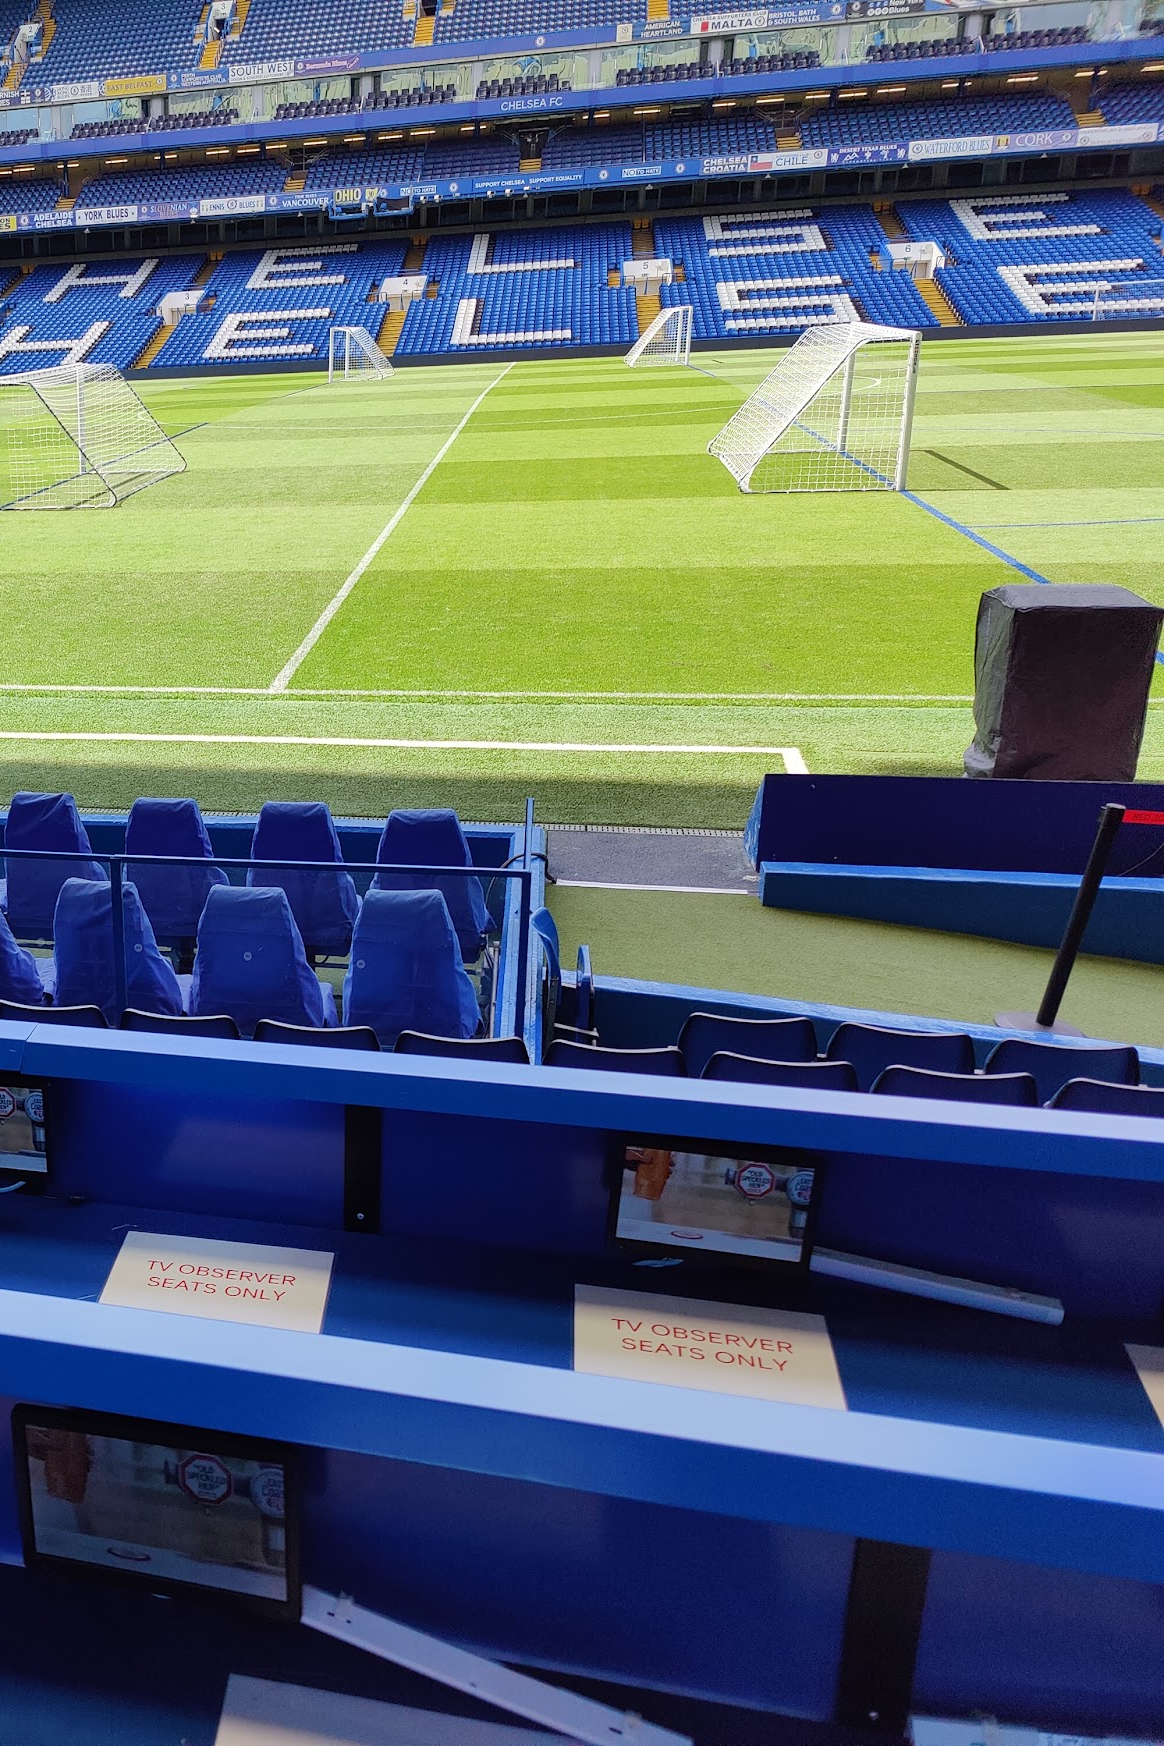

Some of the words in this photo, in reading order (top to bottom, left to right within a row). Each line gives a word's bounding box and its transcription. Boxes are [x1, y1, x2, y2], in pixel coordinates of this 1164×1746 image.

[711, 18, 753, 30] MALTA
[798, 15, 820, 23] WALES
[644, 21, 681, 30] AMERICAN
[640, 28, 683, 38] HEARTLAND
[230, 66, 264, 78] SOUTH
[267, 62, 294, 74] WEST
[124, 80, 153, 90] BELFAST
[500, 98, 547, 110] CHELSEA
[549, 96, 563, 106] FC
[1015, 132, 1054, 147] CORK
[924, 141, 968, 154] WATERFORD
[969, 139, 990, 150] BLUES
[703, 156, 748, 166] CHELSEA
[776, 156, 808, 167] CHILE
[703, 164, 746, 174] CROATIA
[474, 180, 501, 188] SUPPORT
[336, 188, 362, 202] OHIO
[150, 204, 188, 212] SLOVENIAN
[282, 197, 329, 208] VANCOUVER
[34, 211, 74, 222] ADELAIDE
[84, 210, 103, 221] YORK
[106, 208, 129, 218] BLUES
[35, 220, 72, 228] CHELSEA
[742, 1176, 770, 1184] SPECKLED
[148, 1260, 174, 1272] TV
[179, 1264, 296, 1286] OBSERVER
[147, 1276, 217, 1294] SEATS
[225, 1286, 286, 1301] ONLY
[612, 1318, 642, 1332] TV
[651, 1324, 793, 1354] OBSERVER
[622, 1337, 705, 1360] SEATS
[715, 1351, 788, 1372] ONLY
